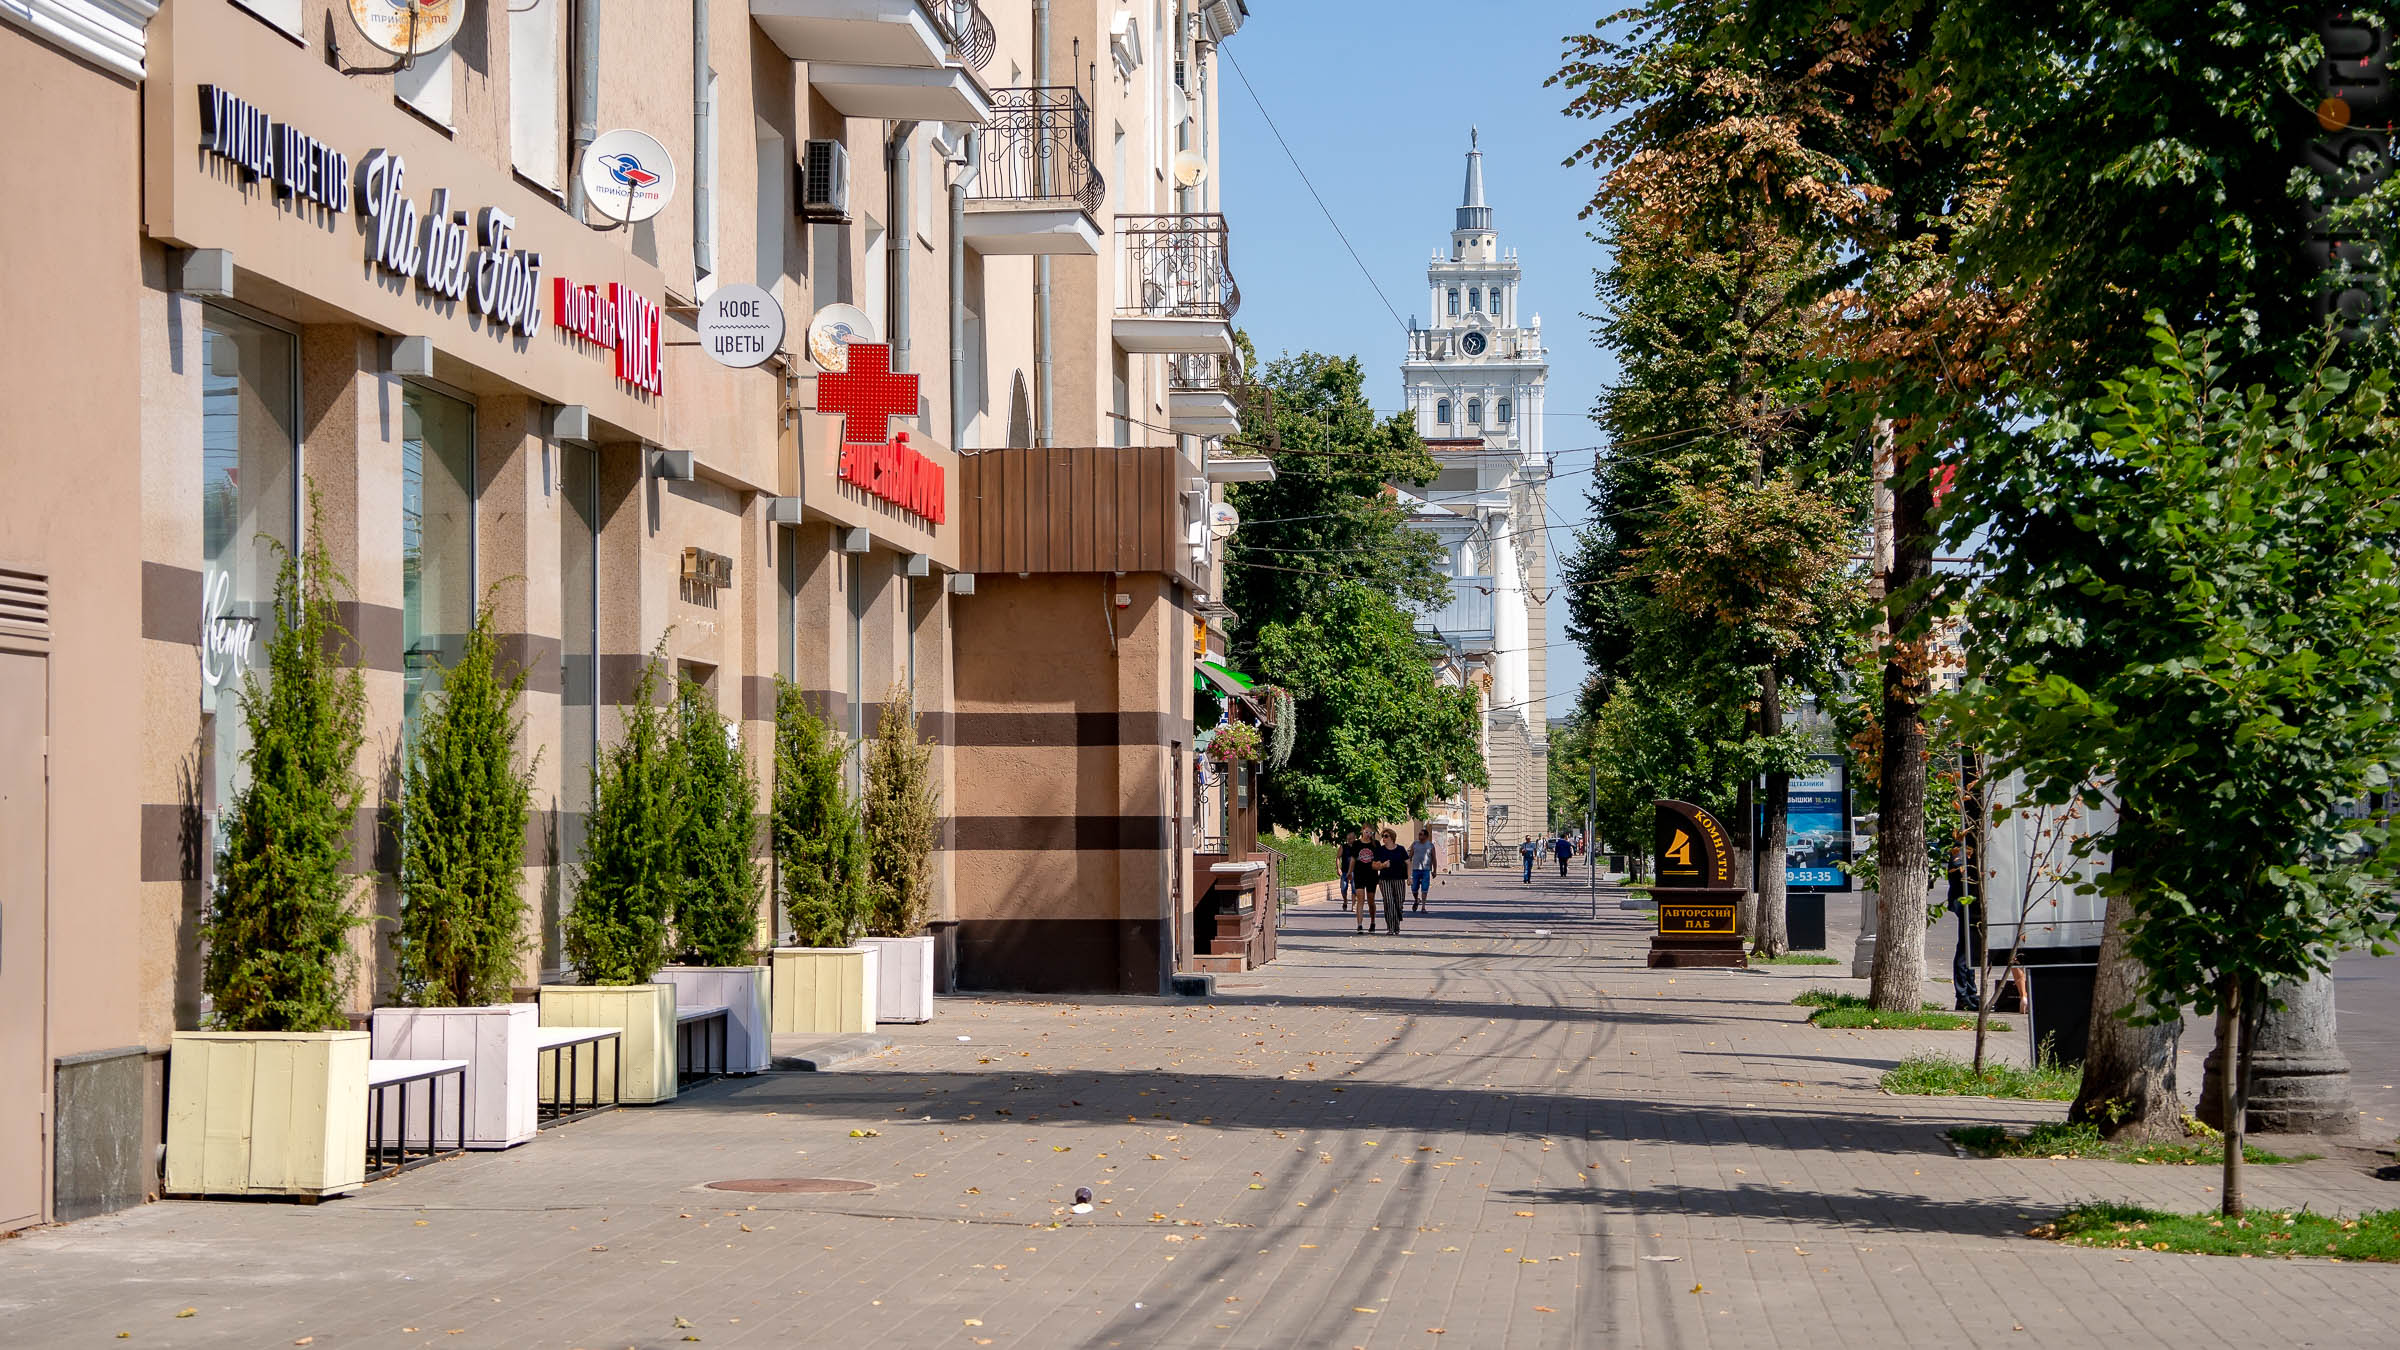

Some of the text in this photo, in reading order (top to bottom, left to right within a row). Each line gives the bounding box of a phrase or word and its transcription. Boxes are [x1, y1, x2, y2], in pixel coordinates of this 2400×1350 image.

[211, 84, 349, 214] УЛИЦА ЦВЕТОВ
[366, 148, 542, 337] Via dei Fiori
[564, 277, 616, 349] КОФЕЙНЯ
[719, 300, 760, 318] КОФЕ
[715, 335, 764, 356] ЦВЕТЫ
[1664, 828, 1692, 865] 4
[1693, 810, 1728, 881] КОМНАТЫ
[1664, 908, 1731, 918] АВТОРСКИЙ
[1685, 920, 1711, 928] ПАБ
